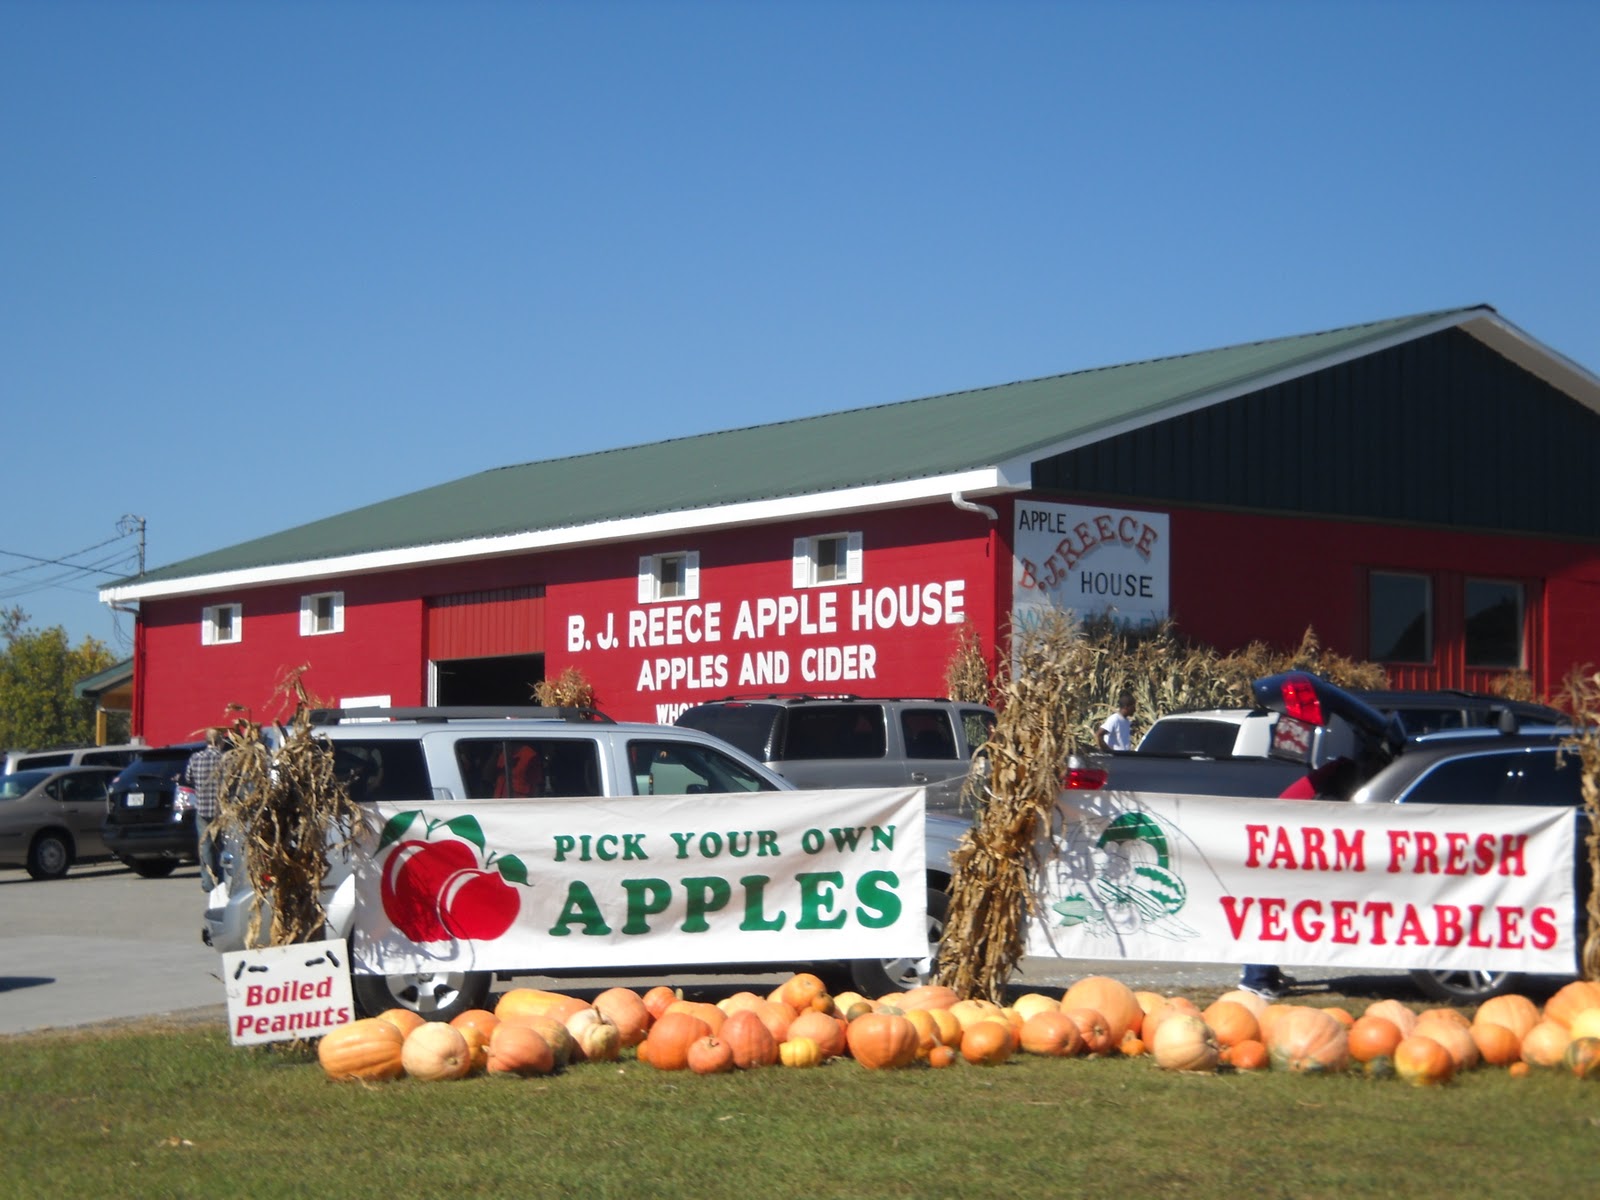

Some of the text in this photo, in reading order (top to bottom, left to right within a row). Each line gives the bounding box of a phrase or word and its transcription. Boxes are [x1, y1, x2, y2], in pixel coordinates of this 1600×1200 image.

[1019, 509, 1067, 534] APPLE
[1081, 571, 1153, 598] HOUSE
[567, 613, 592, 653] B.
[597, 611, 619, 651] J.
[628, 601, 722, 649] REECE
[732, 591, 838, 641] APPLE
[851, 579, 966, 631] HOUSE
[636, 644, 877, 692] APPLES AND CIDER
[553, 824, 897, 862] PICK YOUR OWN
[1245, 823, 1529, 877] FARM FRESH
[549, 869, 903, 936] APPLES
[1219, 895, 1559, 951] VEGETABLES
[245, 976, 334, 1007] Boiled
[235, 1006, 350, 1037] Peanuts
